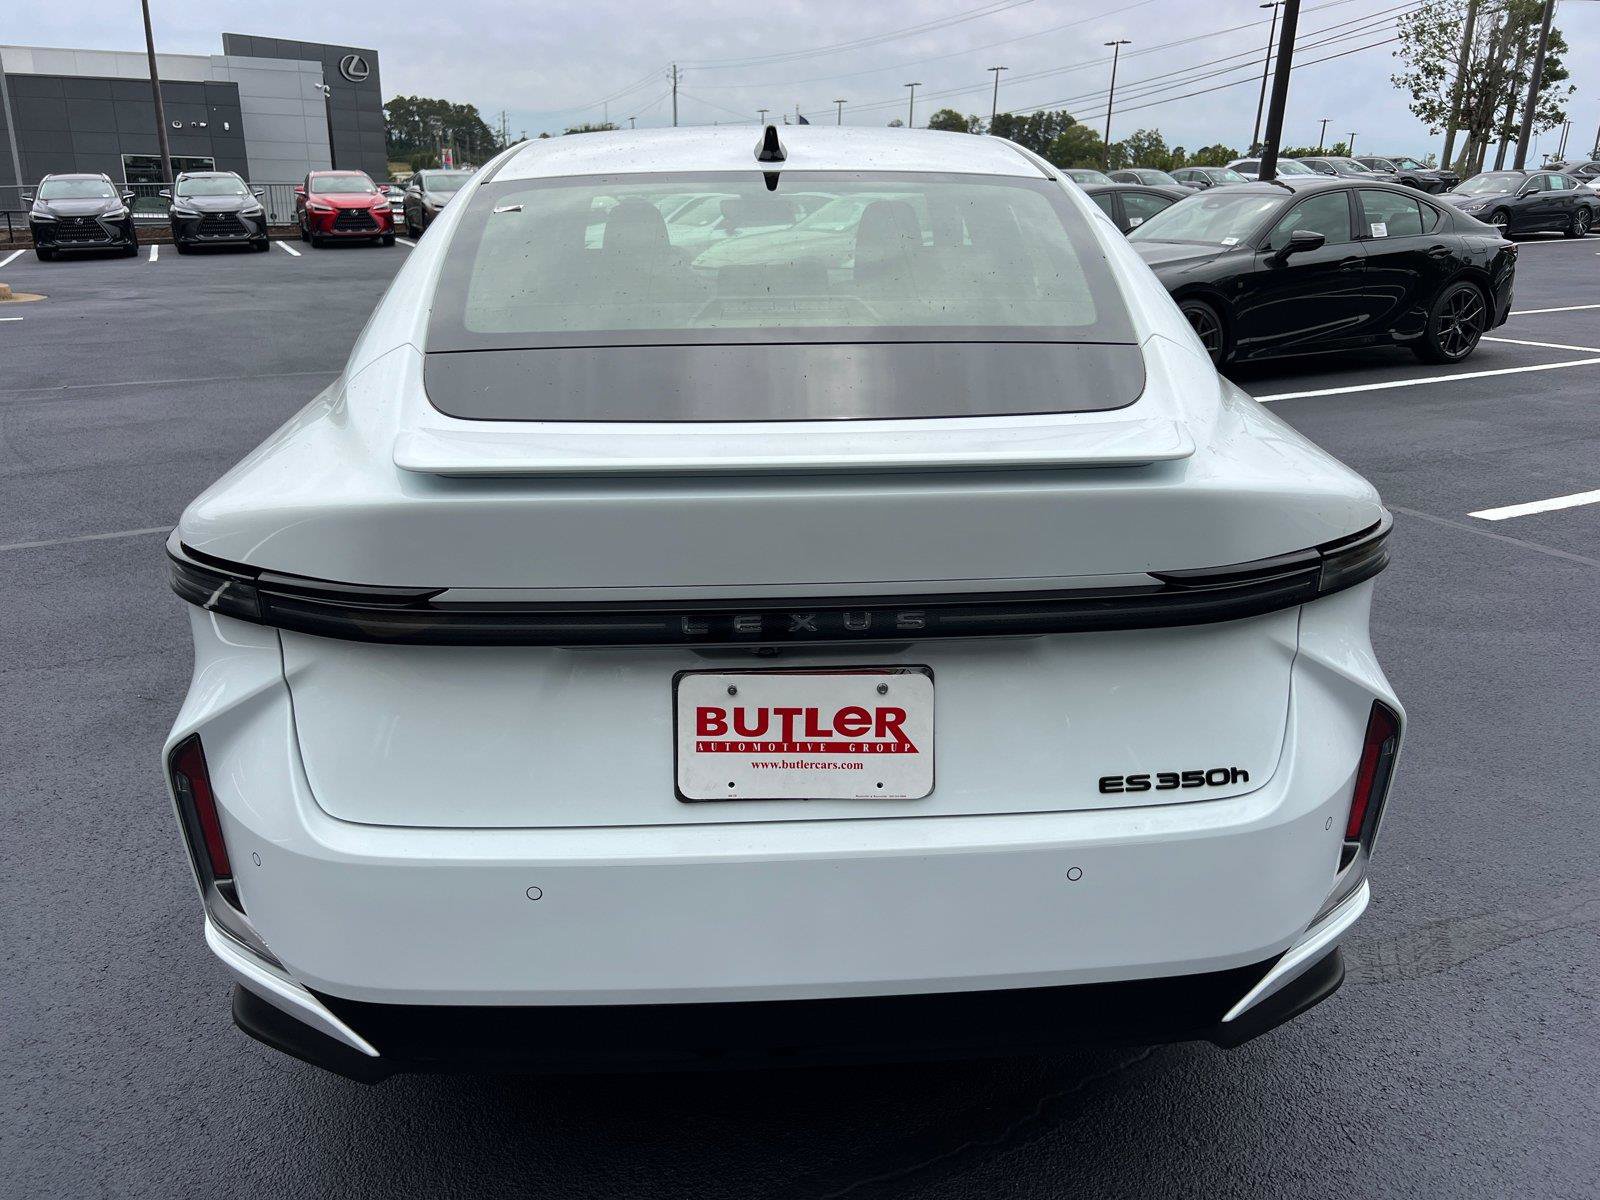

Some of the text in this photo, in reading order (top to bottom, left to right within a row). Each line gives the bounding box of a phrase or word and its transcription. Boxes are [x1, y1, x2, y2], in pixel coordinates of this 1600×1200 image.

[681, 612, 926, 634] LEXUS
[698, 742, 911, 752] AUTOMOTIVE GROUP
[751, 760, 864, 769] www.butlercars.com
[1099, 767, 1249, 794] ES 350h
